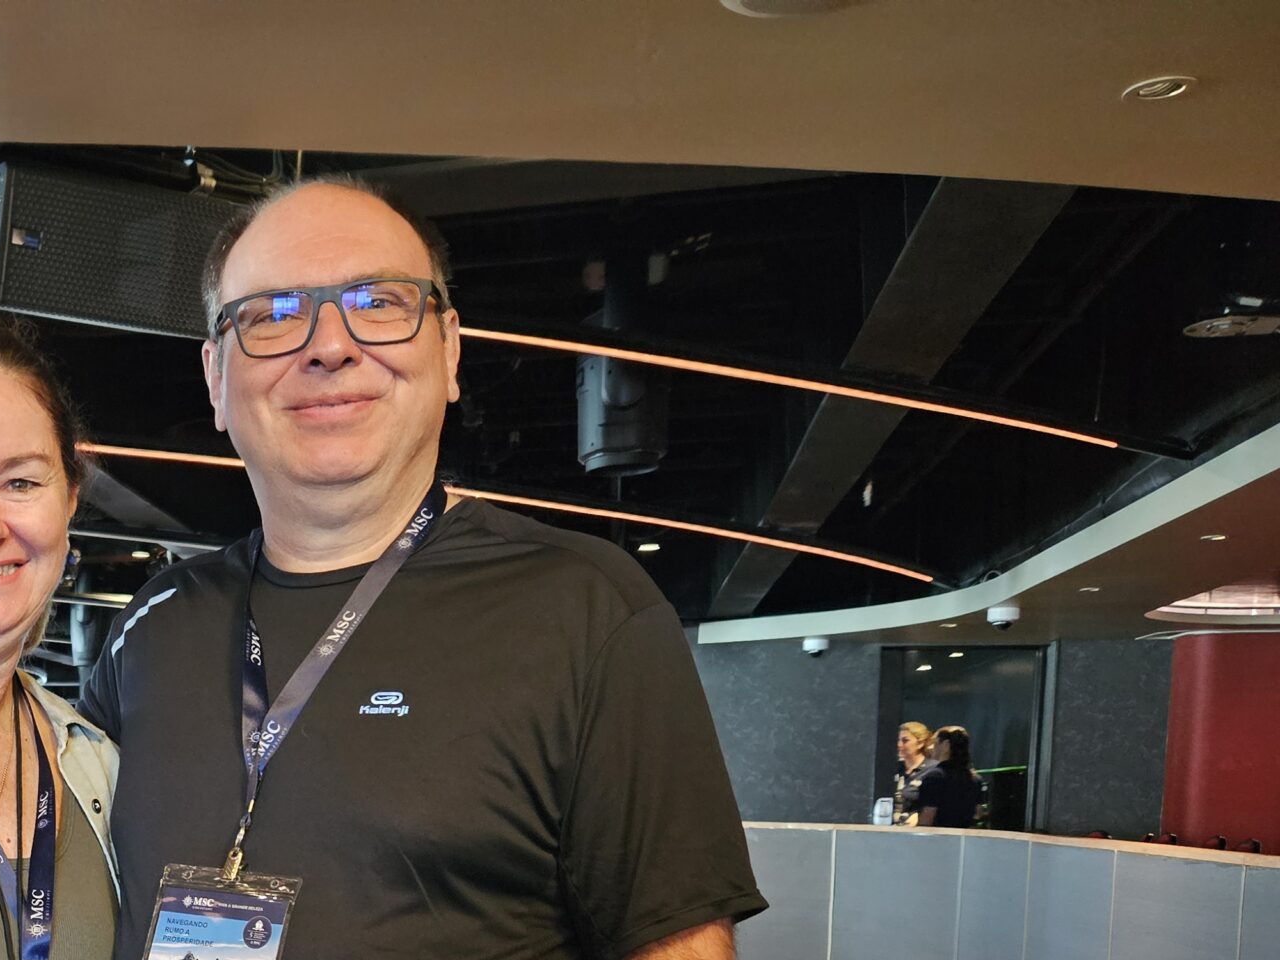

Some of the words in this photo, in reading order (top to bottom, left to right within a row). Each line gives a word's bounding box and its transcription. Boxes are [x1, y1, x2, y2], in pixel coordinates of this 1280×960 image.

[405, 507, 433, 537] MSC
[326, 610, 356, 642] MSC
[250, 631, 262, 666] MSC
[359, 704, 410, 717] Kalenji
[257, 720, 281, 757] MSC
[37, 790, 49, 819] MSC
[30, 889, 45, 920] MSC
[192, 896, 215, 907] MSC
[164, 926, 186, 935] RUMO
[166, 917, 208, 929] NAVEGANDO
[162, 935, 215, 947] PROSPERIDADE
